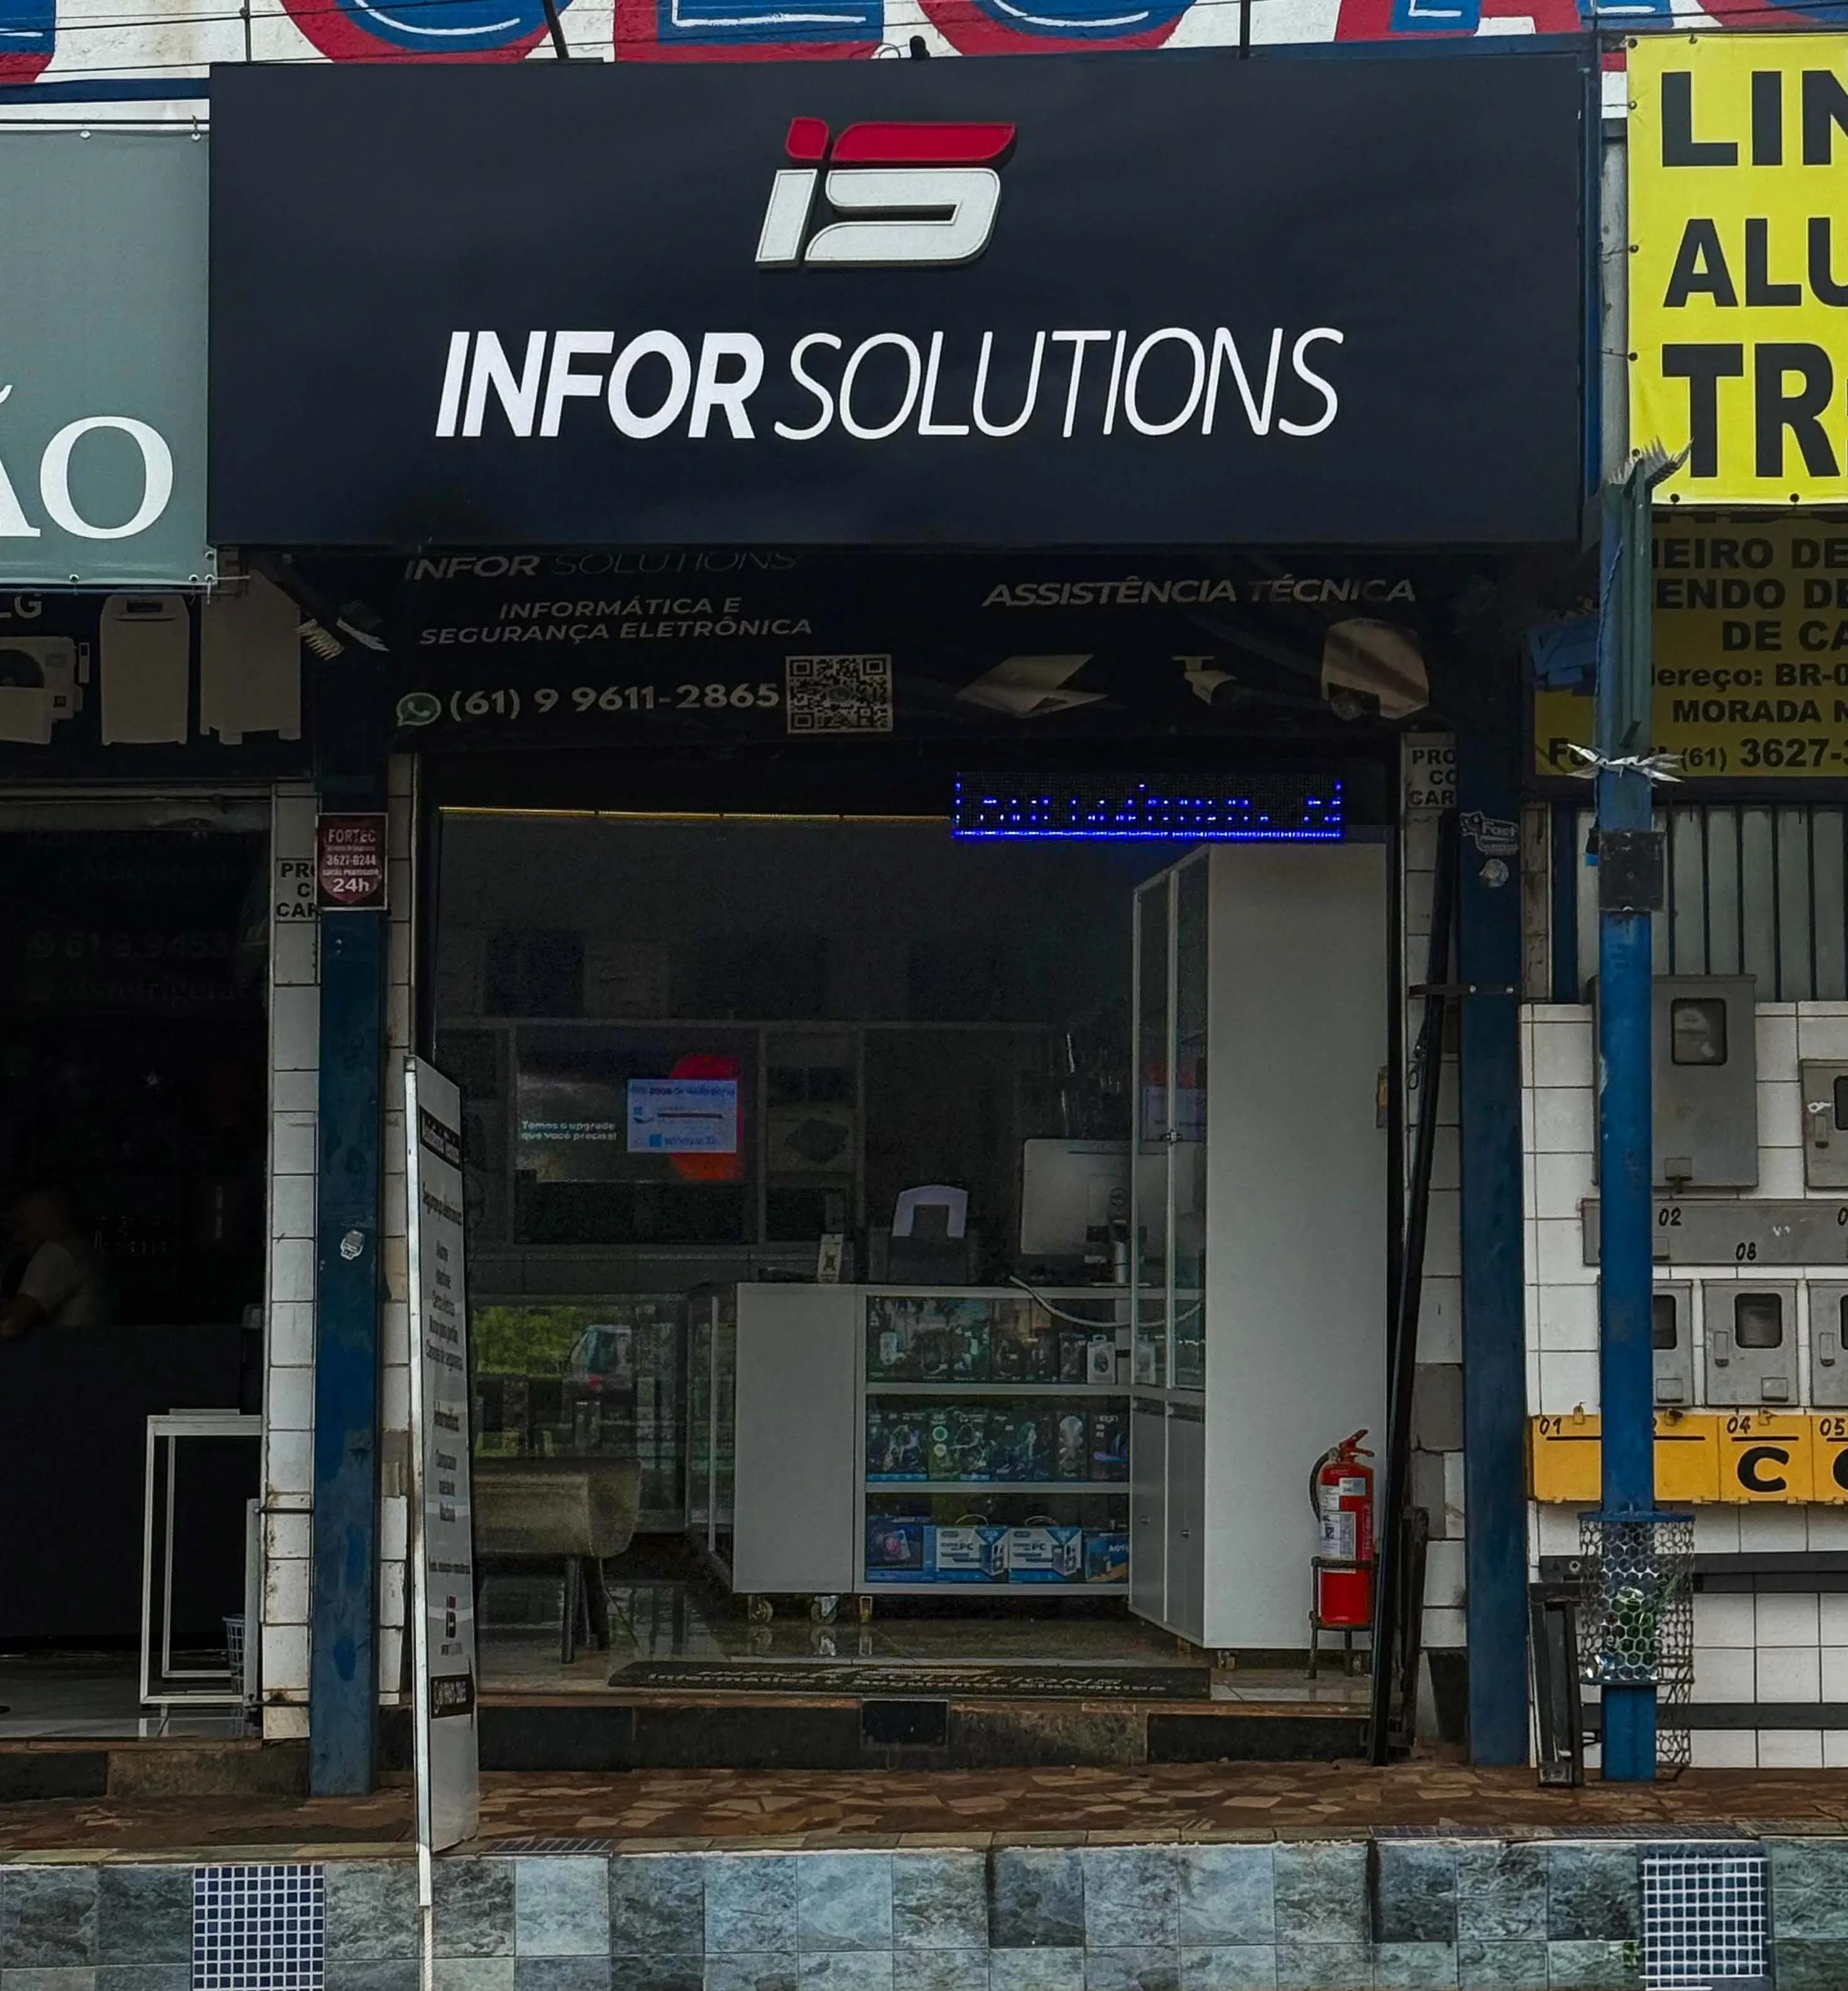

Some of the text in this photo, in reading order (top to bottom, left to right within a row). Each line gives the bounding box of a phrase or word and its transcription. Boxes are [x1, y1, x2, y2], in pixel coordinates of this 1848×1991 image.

[435, 326, 1345, 440] INFOR SOLUTIONS
[404, 555, 542, 581] INFOR
[981, 573, 1416, 608] ASSISTÊNCIA TÉCNICA
[500, 594, 742, 621] INFORMÁTICA E
[419, 616, 814, 646] SEGURANÇA ELETRÔNICA
[1722, 621, 1781, 651] DE
[449, 682, 779, 723] (61) 9 9611-2865
[1672, 700, 1822, 723] MORADA
[1681, 746, 1727, 772] (61)
[332, 878, 370, 893] 24h
[1658, 1208, 1681, 1226] 02
[1539, 1417, 1845, 1437] 01 04 05
